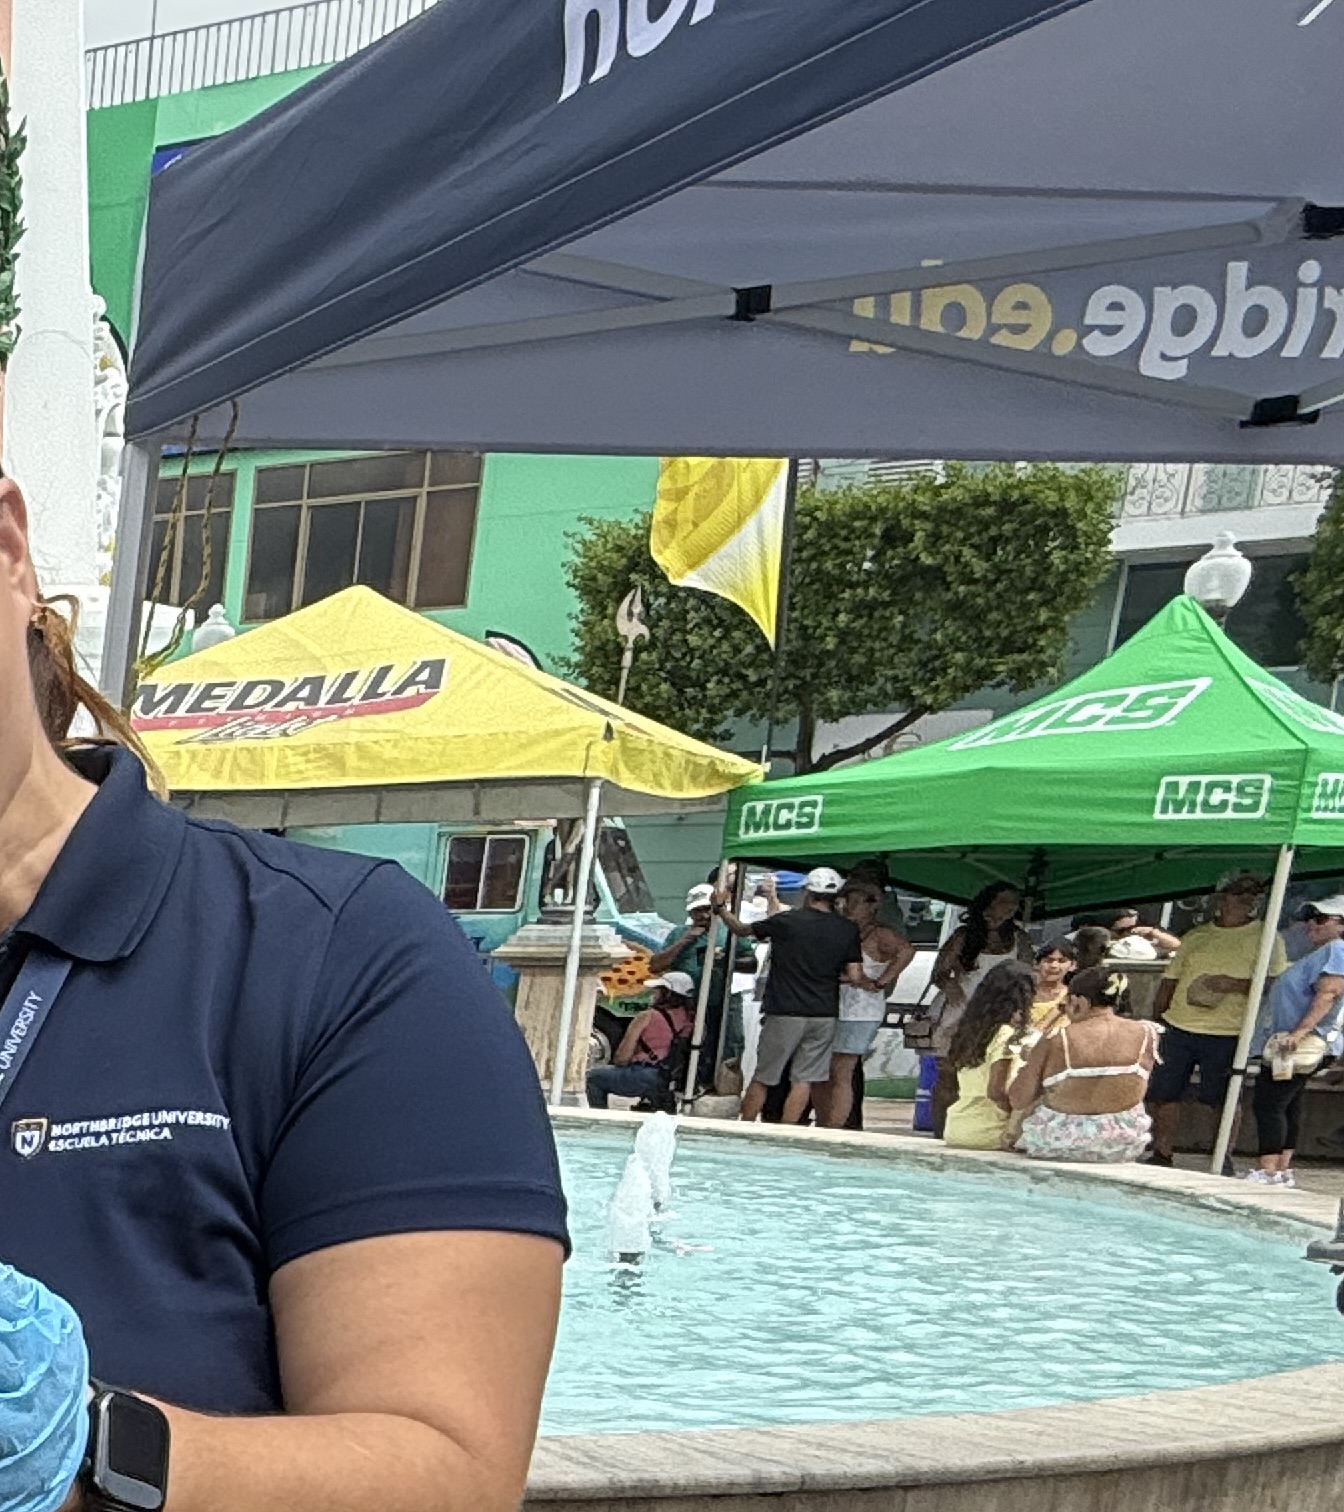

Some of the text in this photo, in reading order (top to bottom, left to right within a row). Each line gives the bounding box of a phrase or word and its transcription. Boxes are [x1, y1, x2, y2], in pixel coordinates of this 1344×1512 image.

[132, 658, 447, 717] MEDALLA
[1159, 779, 1266, 815] MCS
[743, 800, 818, 835] MCS
[51, 1109, 231, 1138] NORTHBRIDGE UNIVERSITY
[48, 1134, 110, 1152] ESCUELA
